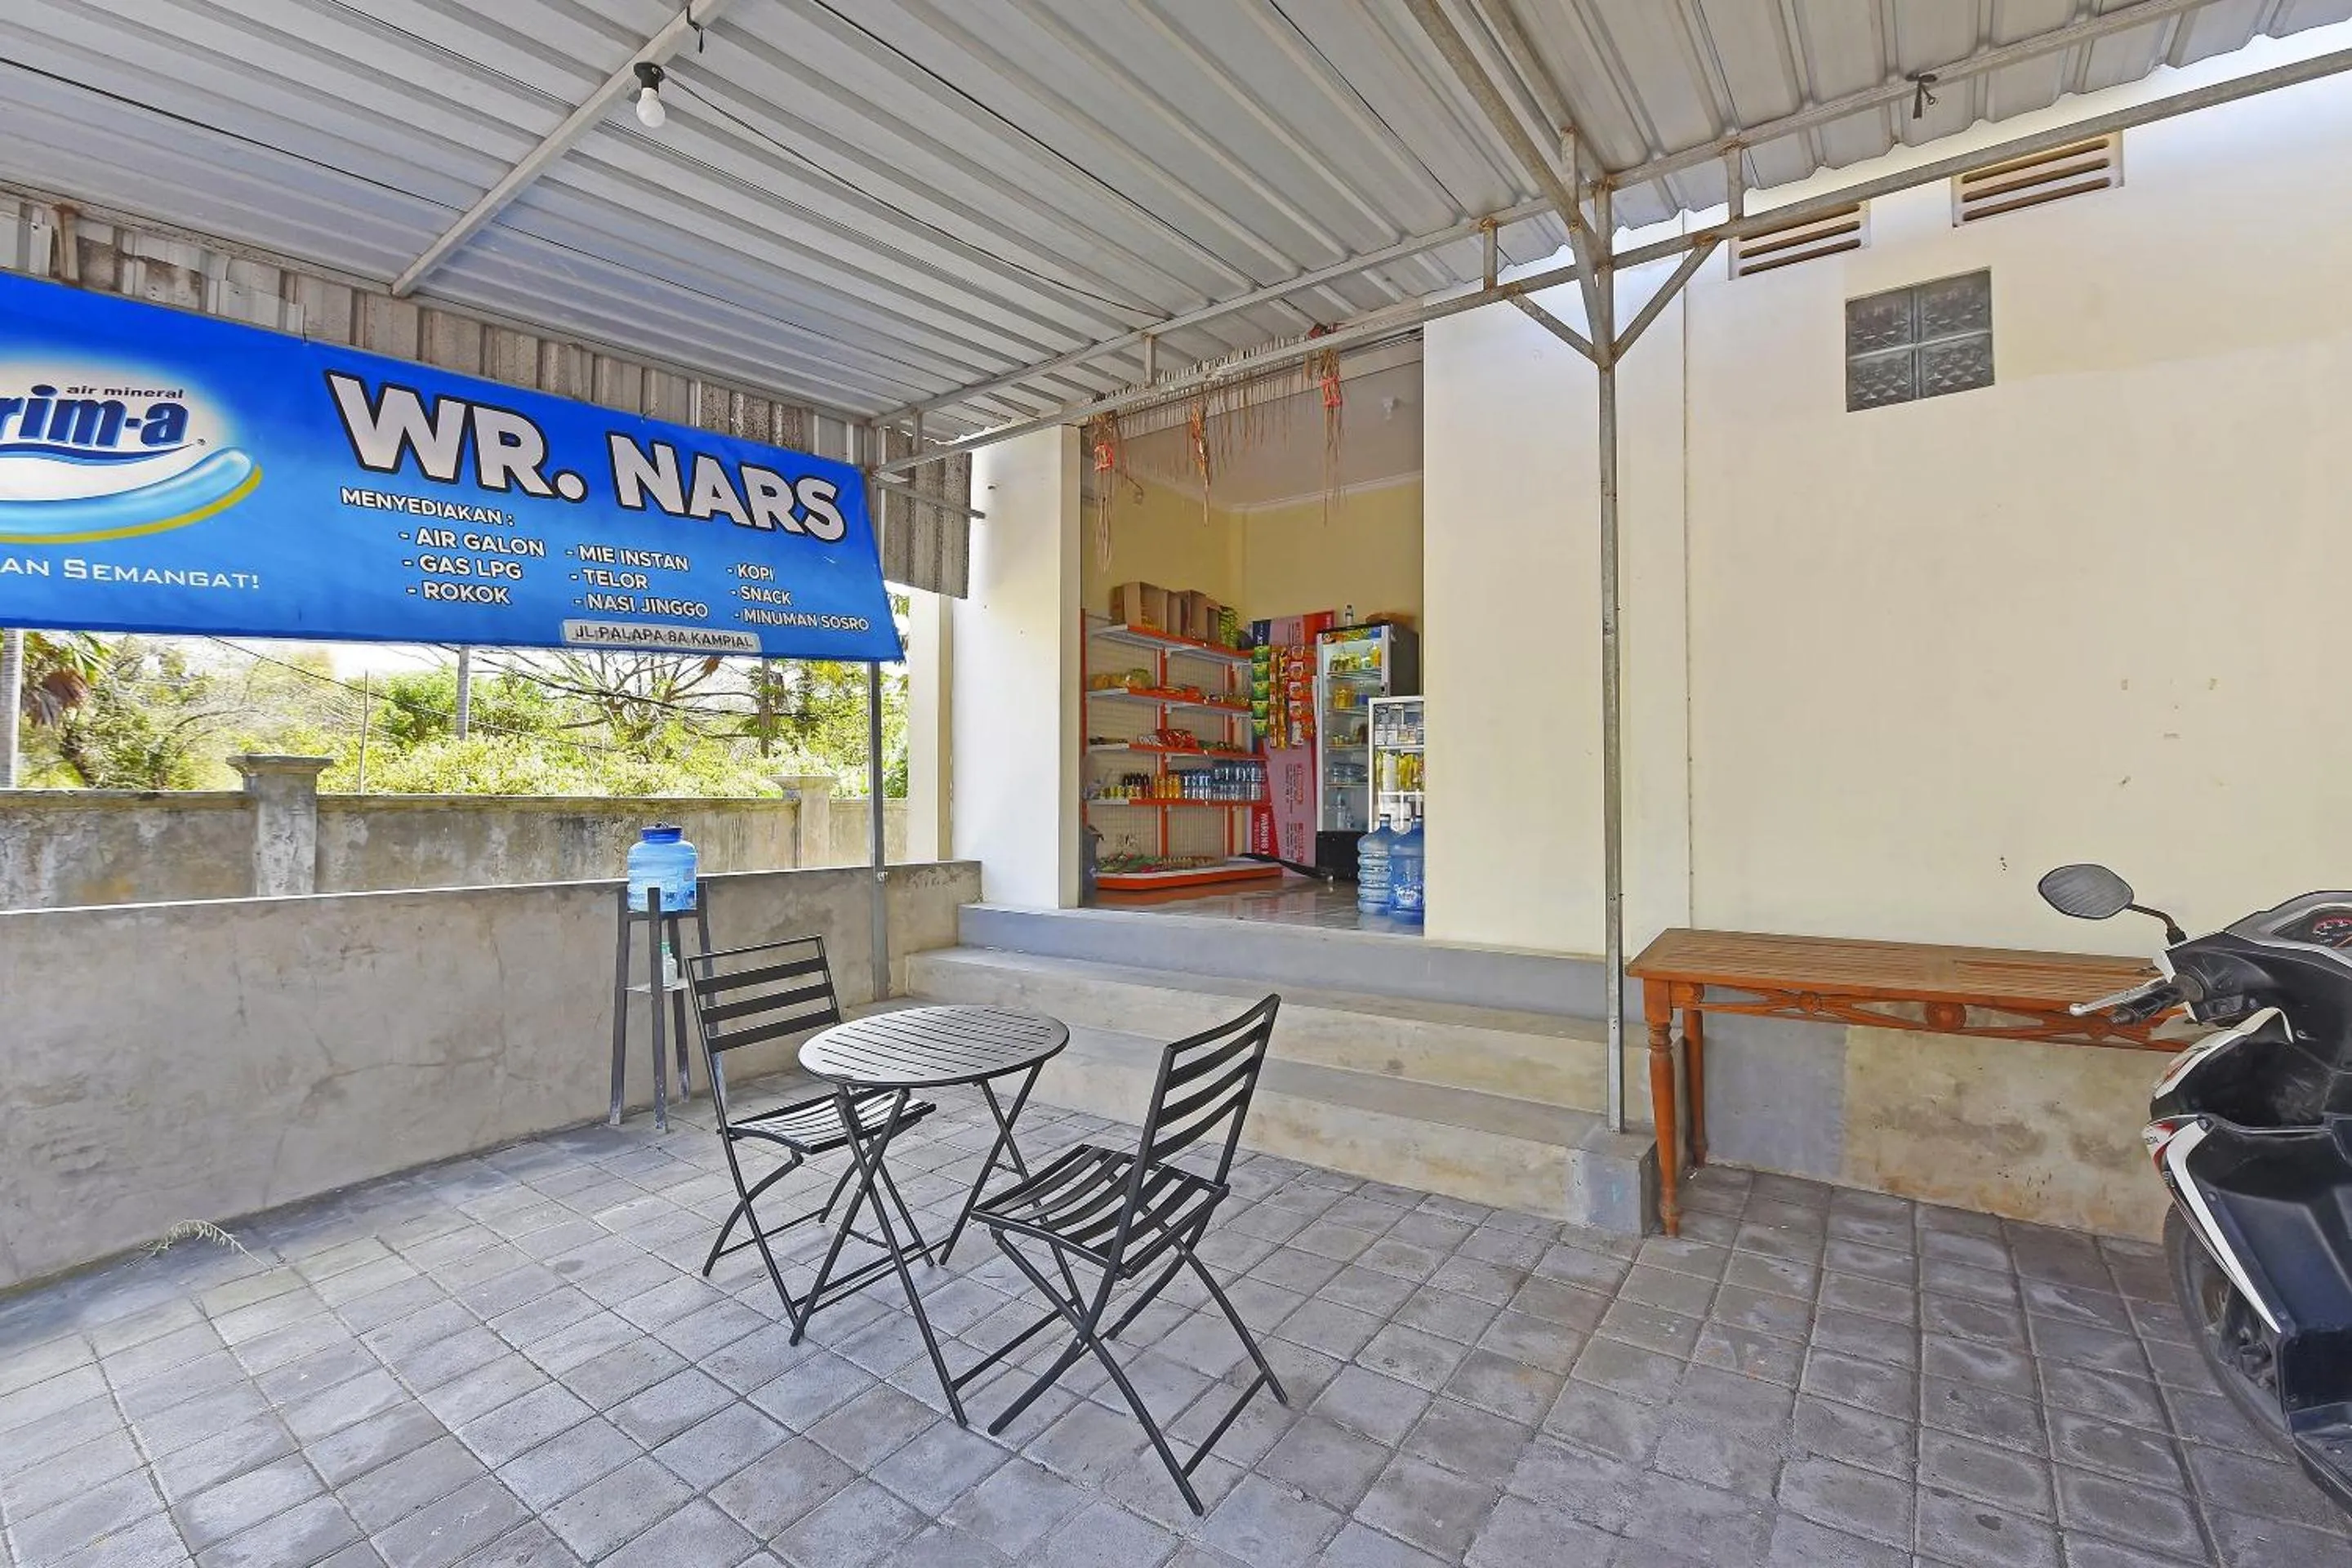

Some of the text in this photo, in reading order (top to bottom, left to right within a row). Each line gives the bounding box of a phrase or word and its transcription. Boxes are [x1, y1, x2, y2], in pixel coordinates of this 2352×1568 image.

[66, 385, 185, 399] air mineral
[326, 370, 847, 544] WR. NARS
[341, 487, 503, 525] MENYEDIAKAN
[416, 528, 458, 549] AIR
[463, 532, 546, 556] GALON
[418, 555, 470, 575] GAS
[476, 559, 523, 580] LPG
[578, 544, 616, 564] MIE
[620, 549, 689, 571] INSTAN
[64, 559, 260, 589] SEMANGAT!
[582, 568, 649, 589] TELOR
[737, 564, 775, 581] KOPI
[421, 581, 511, 605] ROKOK
[740, 585, 792, 606] SNACK
[586, 593, 635, 612] NASI
[641, 597, 708, 618] JINGGO
[743, 608, 817, 627] MINUMAN
[821, 616, 870, 630] SOSRO
[599, 626, 664, 640] PALAPA
[691, 632, 753, 647] KAMPIAL
